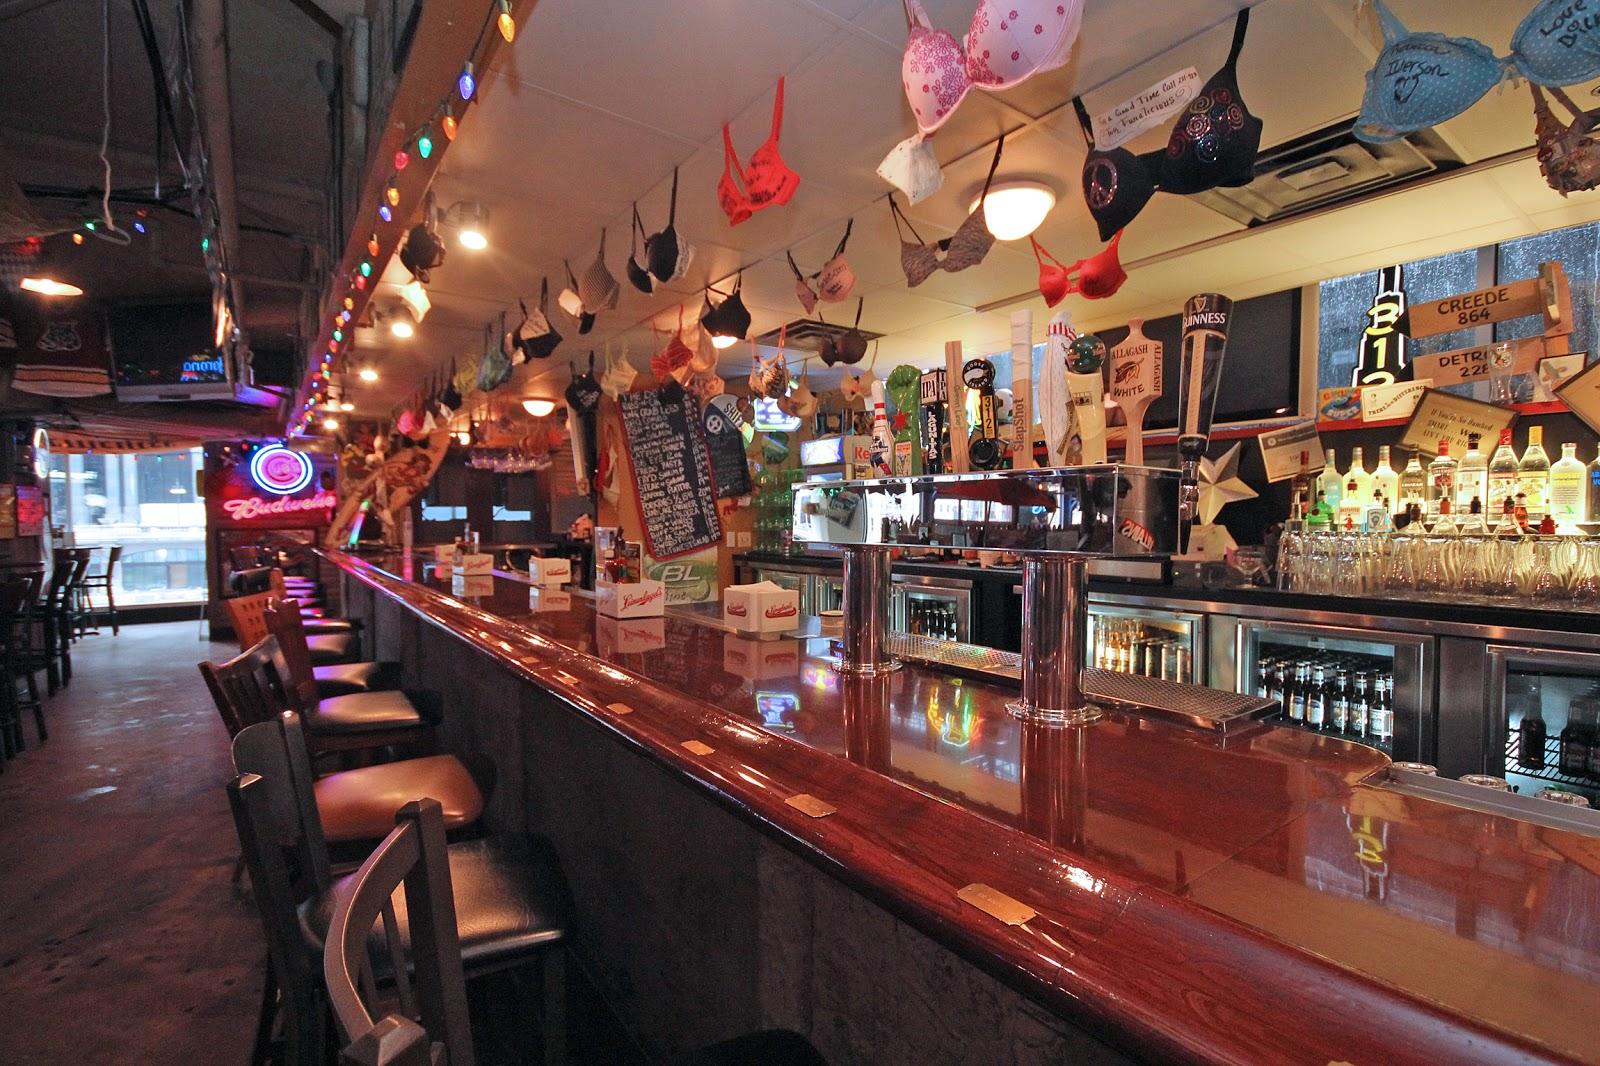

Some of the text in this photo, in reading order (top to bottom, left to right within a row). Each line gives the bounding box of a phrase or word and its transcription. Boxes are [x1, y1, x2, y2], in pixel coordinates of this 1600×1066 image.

[1137, 90, 1160, 104] Time
[1163, 80, 1176, 92] Call
[1438, 288, 1509, 315] CREEDE
[1183, 312, 1227, 327] GUINNESS
[1458, 308, 1490, 326] 864
[1112, 344, 1148, 360] ALLAGASH
[922, 379, 936, 399] IPA
[1114, 384, 1145, 397] WHITE
[984, 396, 992, 429] 312
[1013, 397, 1027, 452] SlapShot
[927, 411, 938, 460] LAGUNITAS
[661, 565, 701, 581] BL
